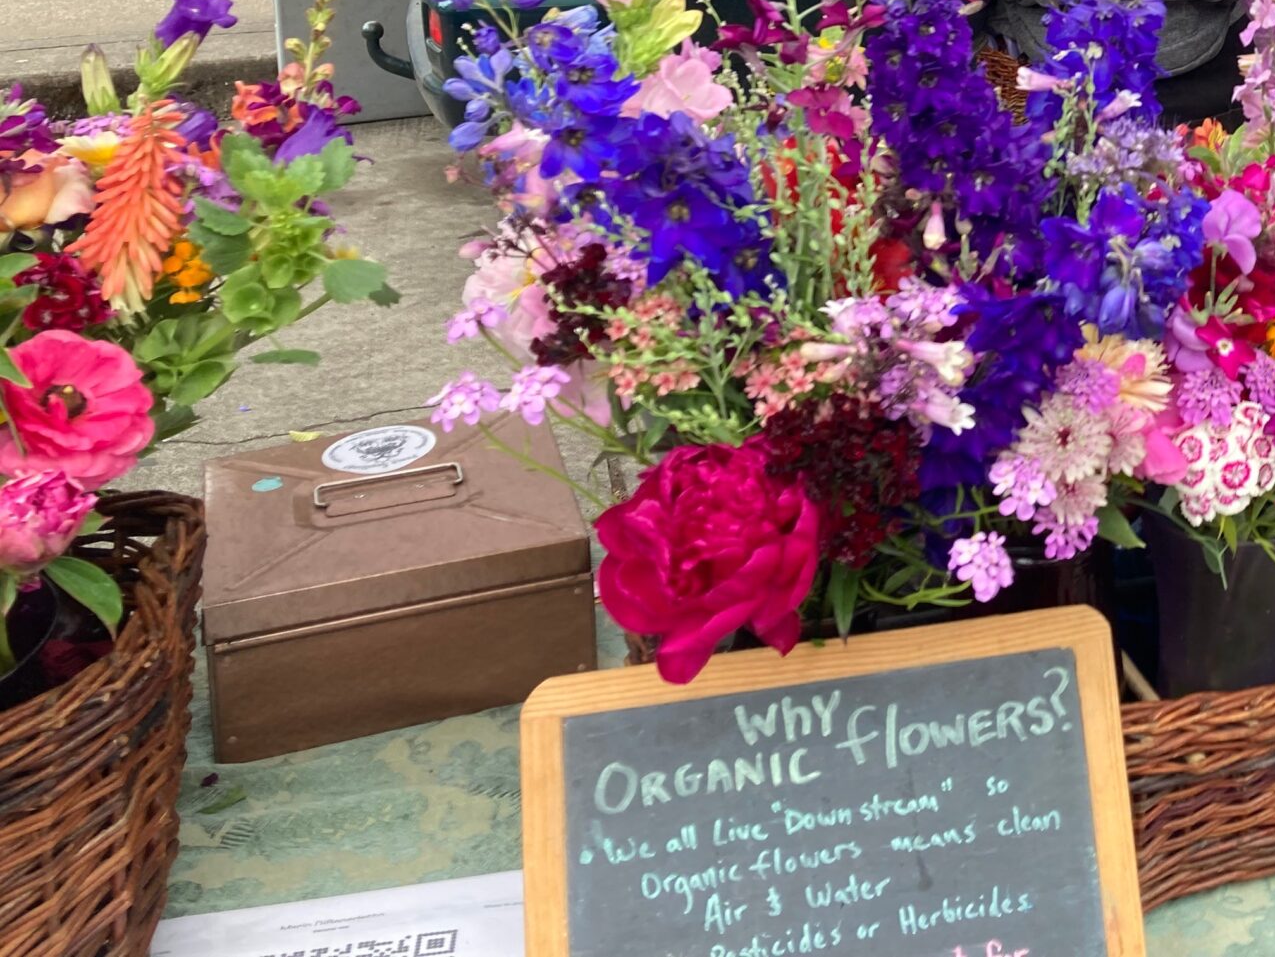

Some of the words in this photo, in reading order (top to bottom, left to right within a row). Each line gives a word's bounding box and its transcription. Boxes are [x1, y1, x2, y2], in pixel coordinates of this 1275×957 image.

[594, 748, 822, 815] ORGANIC
[602, 837, 656, 865] We
[666, 823, 697, 851] all
[713, 817, 769, 846] Live
[749, 841, 863, 880] flowers
[891, 823, 976, 852] means
[997, 805, 1061, 837] clean
[704, 892, 748, 935] Air
[805, 874, 892, 908] Water
[856, 921, 880, 940] or
[899, 885, 1034, 935] Herbicides
